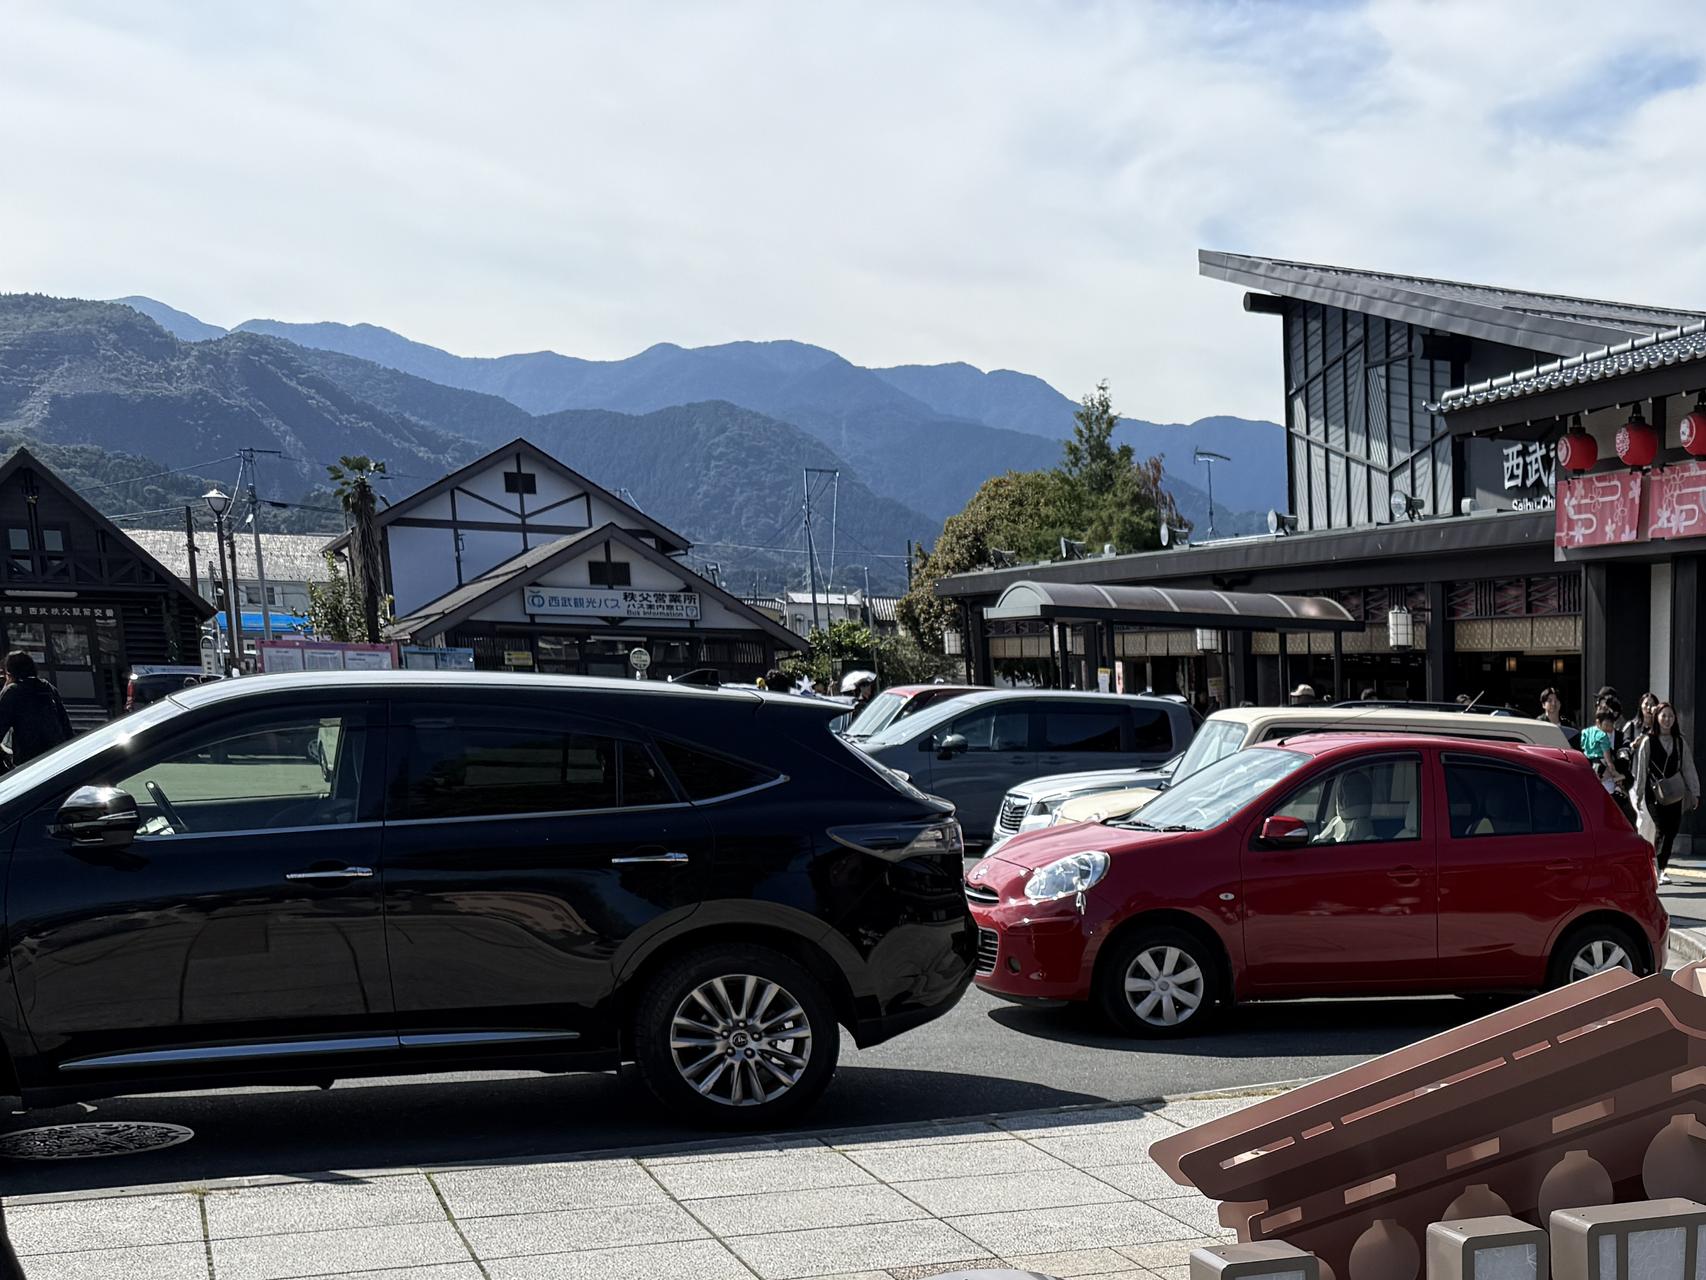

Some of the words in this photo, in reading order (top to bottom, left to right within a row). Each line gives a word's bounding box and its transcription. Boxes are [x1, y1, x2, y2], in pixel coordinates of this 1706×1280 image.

[548, 595, 620, 609] 西武観光バス
[623, 592, 697, 605] 秩父営業所
